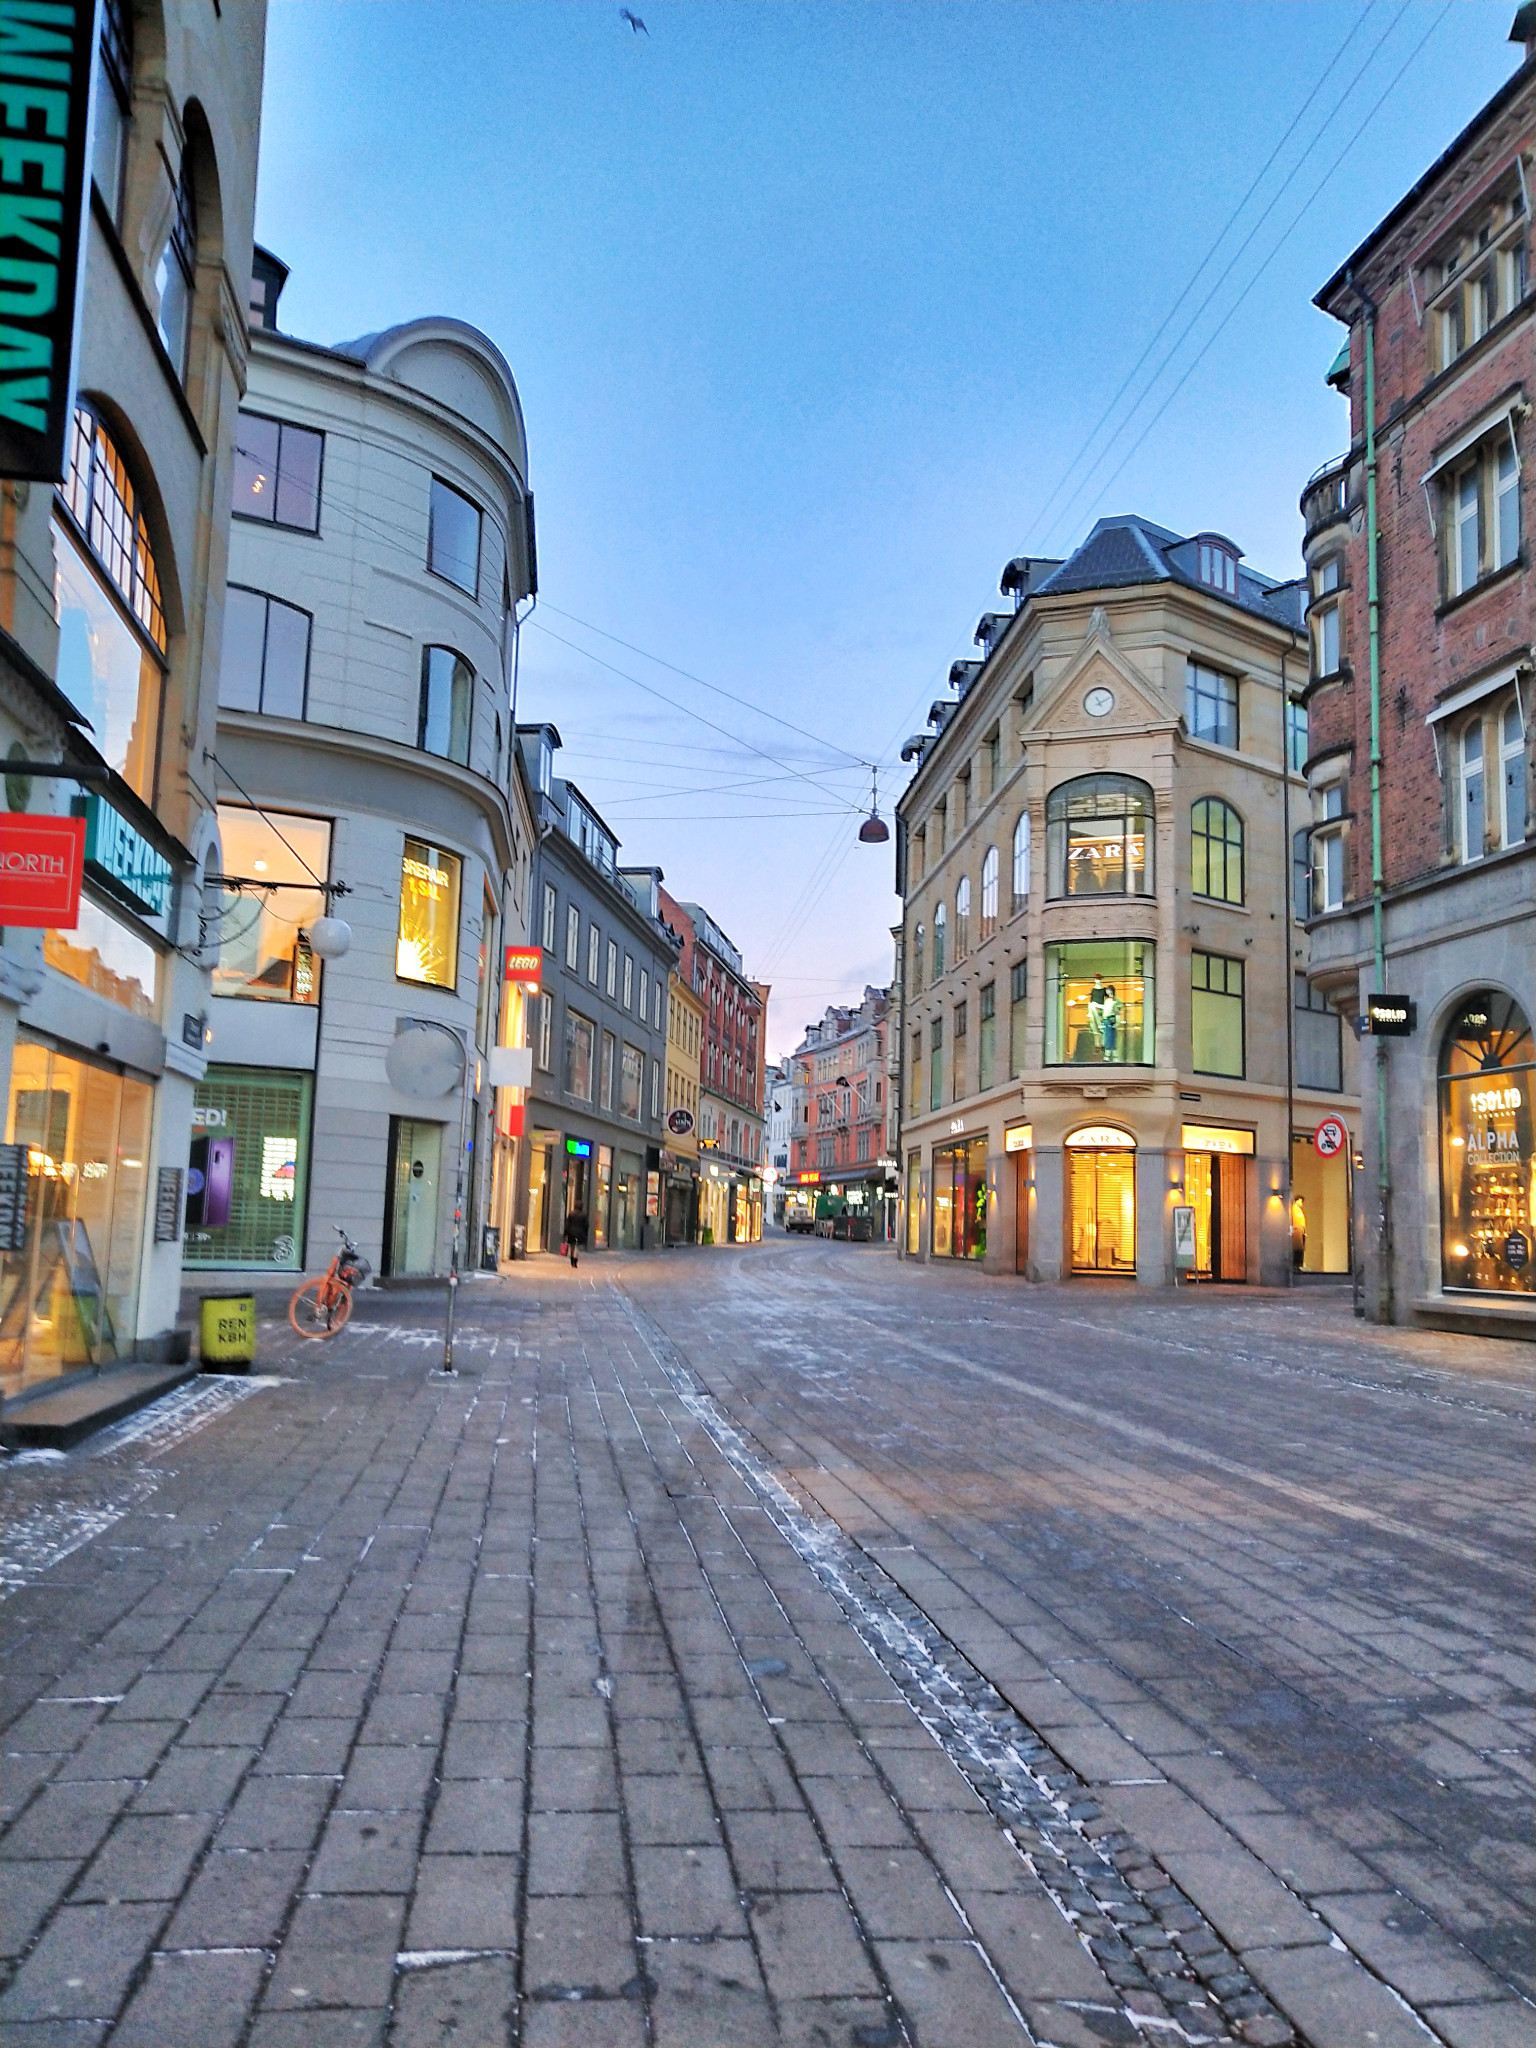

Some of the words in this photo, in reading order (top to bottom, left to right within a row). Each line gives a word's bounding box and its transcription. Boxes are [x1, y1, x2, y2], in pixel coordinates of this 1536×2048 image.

[1068, 843, 1142, 860] ZARA
[508, 956, 539, 969] LEGO
[1467, 1130, 1520, 1152] ALPHA
[1467, 1151, 1520, 1166] COLLECTION
[218, 1319, 247, 1330] REN
[218, 1333, 247, 1344] KBH
